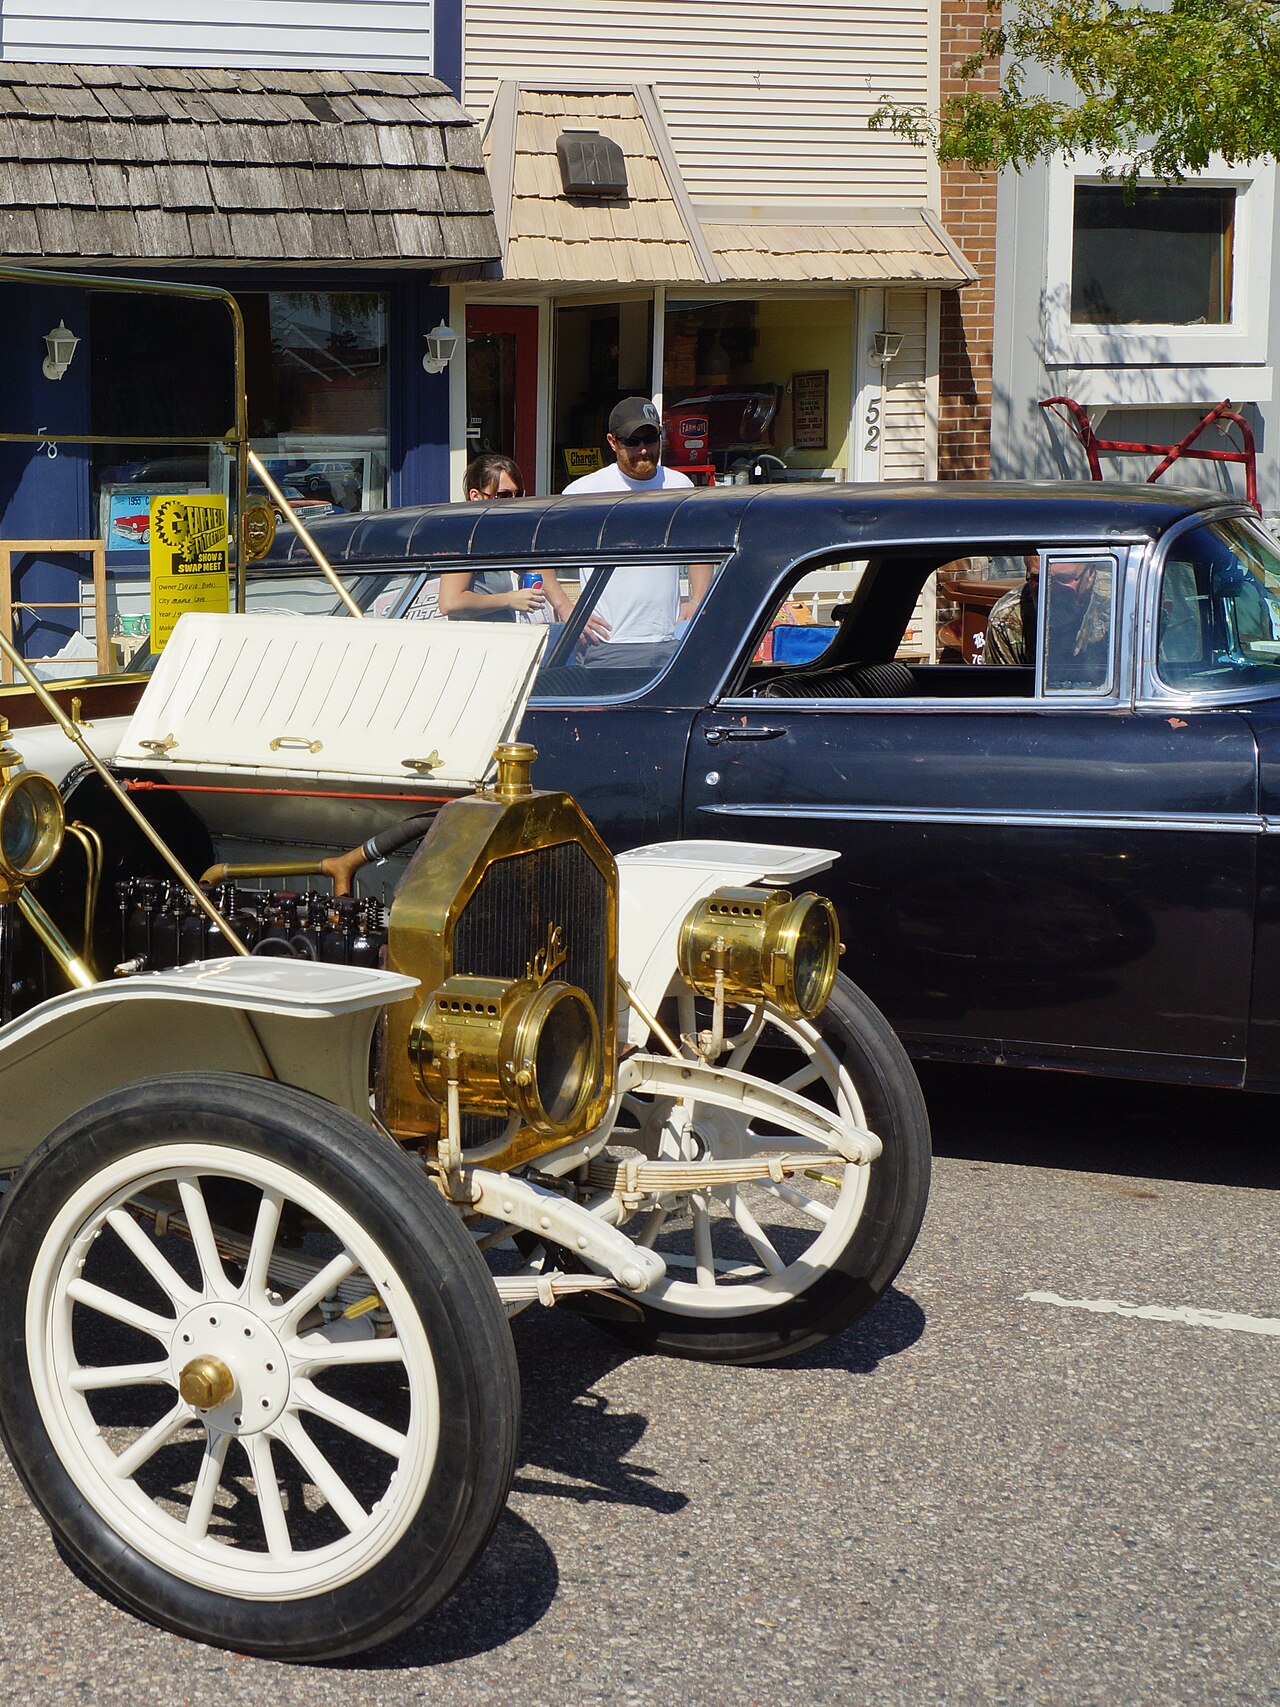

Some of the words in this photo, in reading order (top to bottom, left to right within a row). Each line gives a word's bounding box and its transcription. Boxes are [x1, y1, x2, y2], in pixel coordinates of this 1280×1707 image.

[865, 397, 881, 451] 52
[570, 449, 599, 467] Charge!
[198, 552, 218, 562] SHOW
[178, 564, 202, 573] SWAP
[203, 562, 222, 571] MEET
